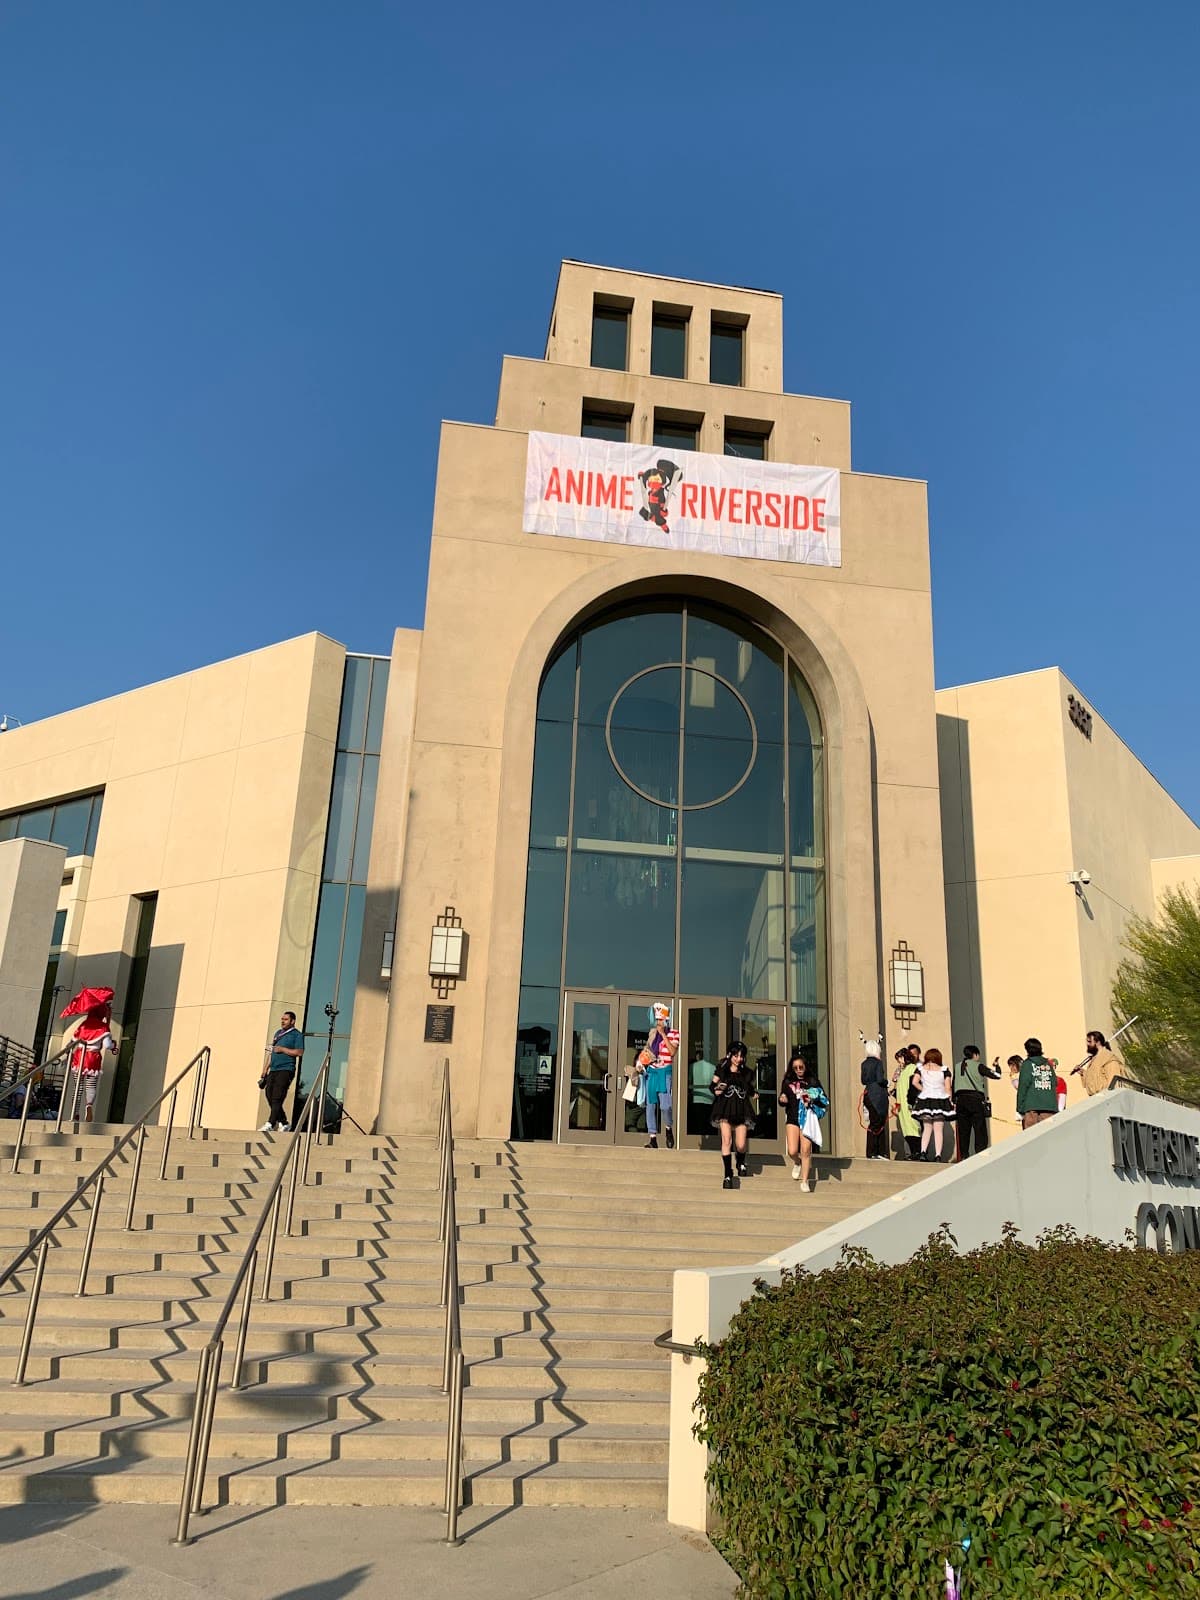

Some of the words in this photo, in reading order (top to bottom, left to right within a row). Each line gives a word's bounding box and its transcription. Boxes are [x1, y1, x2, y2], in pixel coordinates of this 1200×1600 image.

[545, 467, 634, 511] ANIME
[681, 483, 826, 532] RIVERSIDE
[540, 1060, 548, 1069] A
[1137, 1202, 1200, 1254] CON
